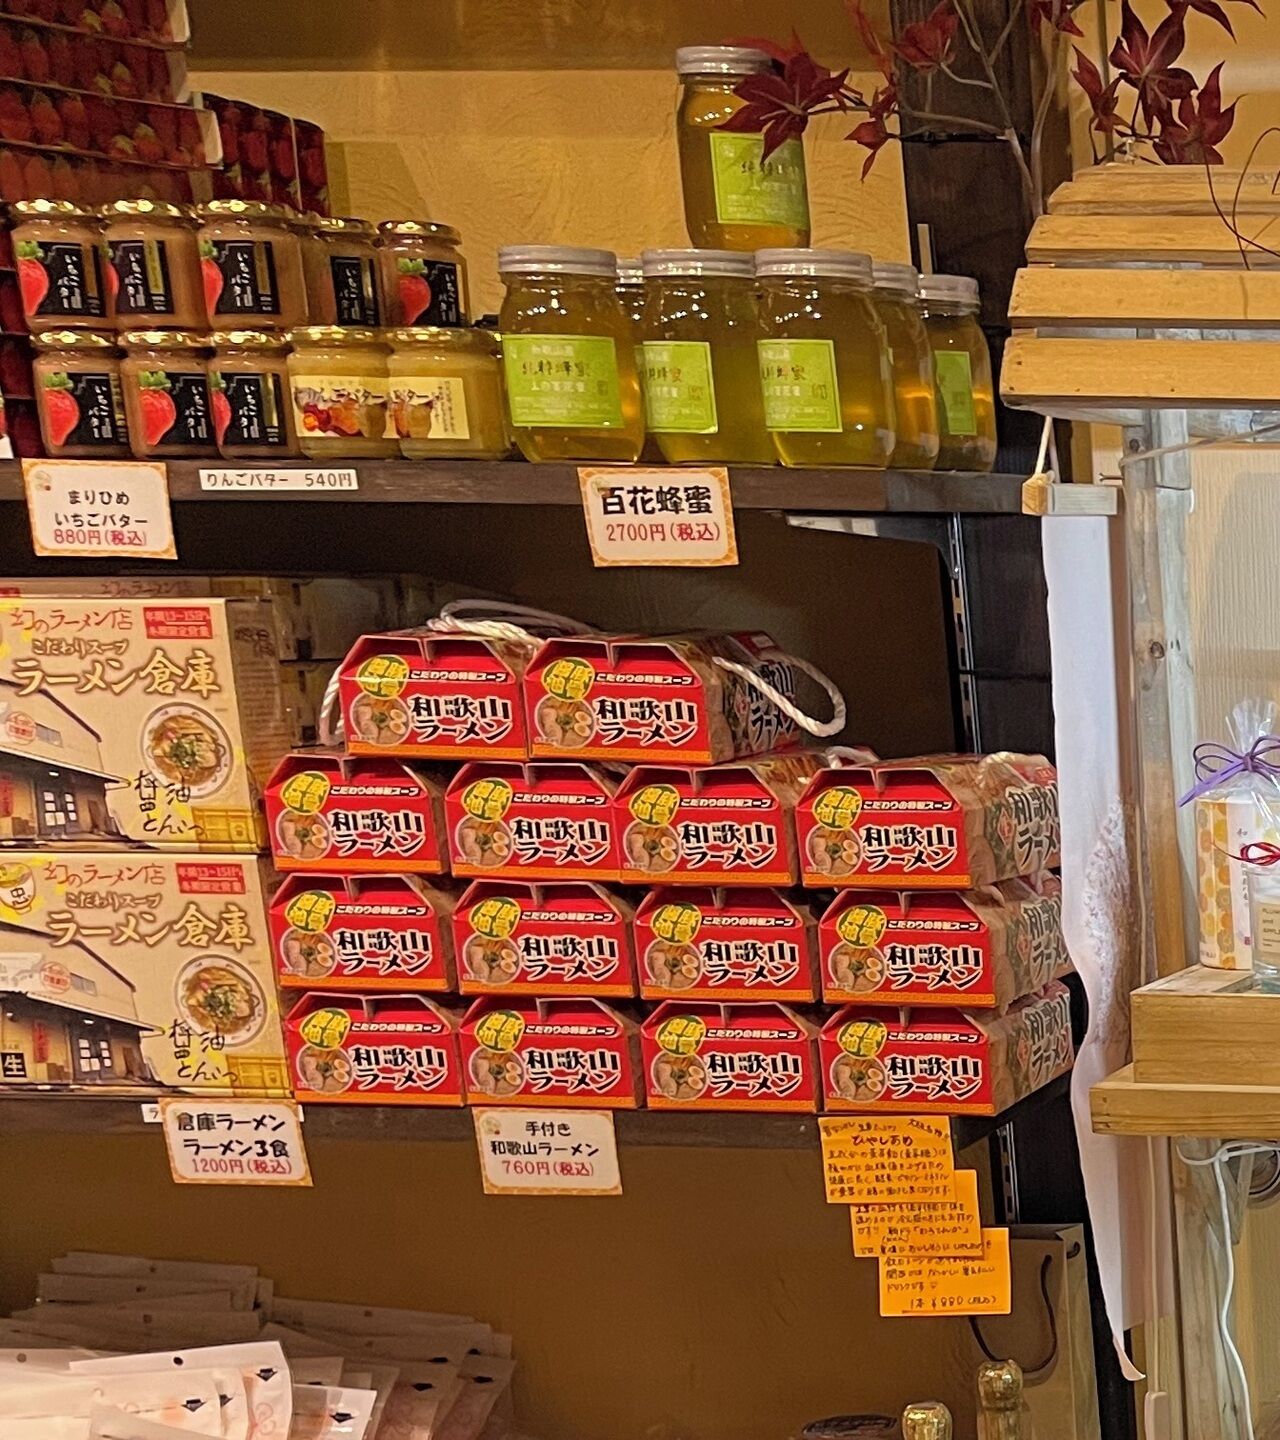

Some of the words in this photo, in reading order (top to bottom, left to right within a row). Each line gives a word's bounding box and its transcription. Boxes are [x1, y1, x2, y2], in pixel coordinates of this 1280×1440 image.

[207, 473, 288, 487] りんごバター
[304, 472, 352, 487] 540円
[68, 490, 129, 505] まりひめ
[599, 485, 713, 516] 百花蜂蜜
[54, 512, 148, 527] いちごバター
[54, 529, 147, 546] 880円(税込)
[605, 523, 721, 544] 2700円(税込)
[10, 608, 133, 632] 幻のラーメン店
[32, 638, 129, 657] こだわりスープ
[13, 647, 221, 700] ラーメン倉庫
[411, 696, 511, 719] 和歌山
[596, 699, 696, 722] 和歌山
[414, 719, 511, 742] ラーメン
[599, 722, 696, 746] ラーメン
[331, 811, 423, 833] 和歌山
[513, 819, 608, 841] 和歌山
[334, 832, 424, 856] ラーメン
[681, 824, 776, 846] 和歌山
[863, 826, 956, 848] 和歌山
[517, 841, 609, 864] ラーメン
[685, 846, 776, 869] ラーメン
[867, 848, 957, 871] ラーメン
[44, 862, 166, 887] 幻のラーメン店
[65, 892, 162, 911] こだわりスープ
[46, 903, 254, 951] ラーメン倉庫
[337, 930, 431, 952] 和歌山
[522, 936, 617, 958] 和歌山
[703, 941, 797, 963] 和歌山
[340, 951, 431, 974] ラーメン
[888, 946, 981, 968] 和歌山
[526, 958, 617, 981] ラーメン
[705, 964, 797, 986] ラーメン
[890, 968, 982, 990] ラーメン
[353, 1047, 446, 1068] 和歌山
[527, 1050, 619, 1070] 和歌山
[707, 1053, 801, 1076] 和歌山
[889, 1056, 980, 1078] 和歌山
[357, 1068, 446, 1090] ラーメン
[530, 1070, 620, 1091] ラーメン
[711, 1076, 801, 1097] ラーメン
[890, 1078, 981, 1099] ラーメン
[177, 1113, 285, 1132] 倉庫ラーメン
[526, 1122, 571, 1136] 手付き
[184, 1140, 290, 1158] ラーメン3食
[491, 1142, 599, 1158] 和歌山ラーメン
[852, 1135, 913, 1146] ひやしあめ
[192, 1159, 292, 1175] 1200円(税込)
[502, 1161, 594, 1176] 760円(税込)
